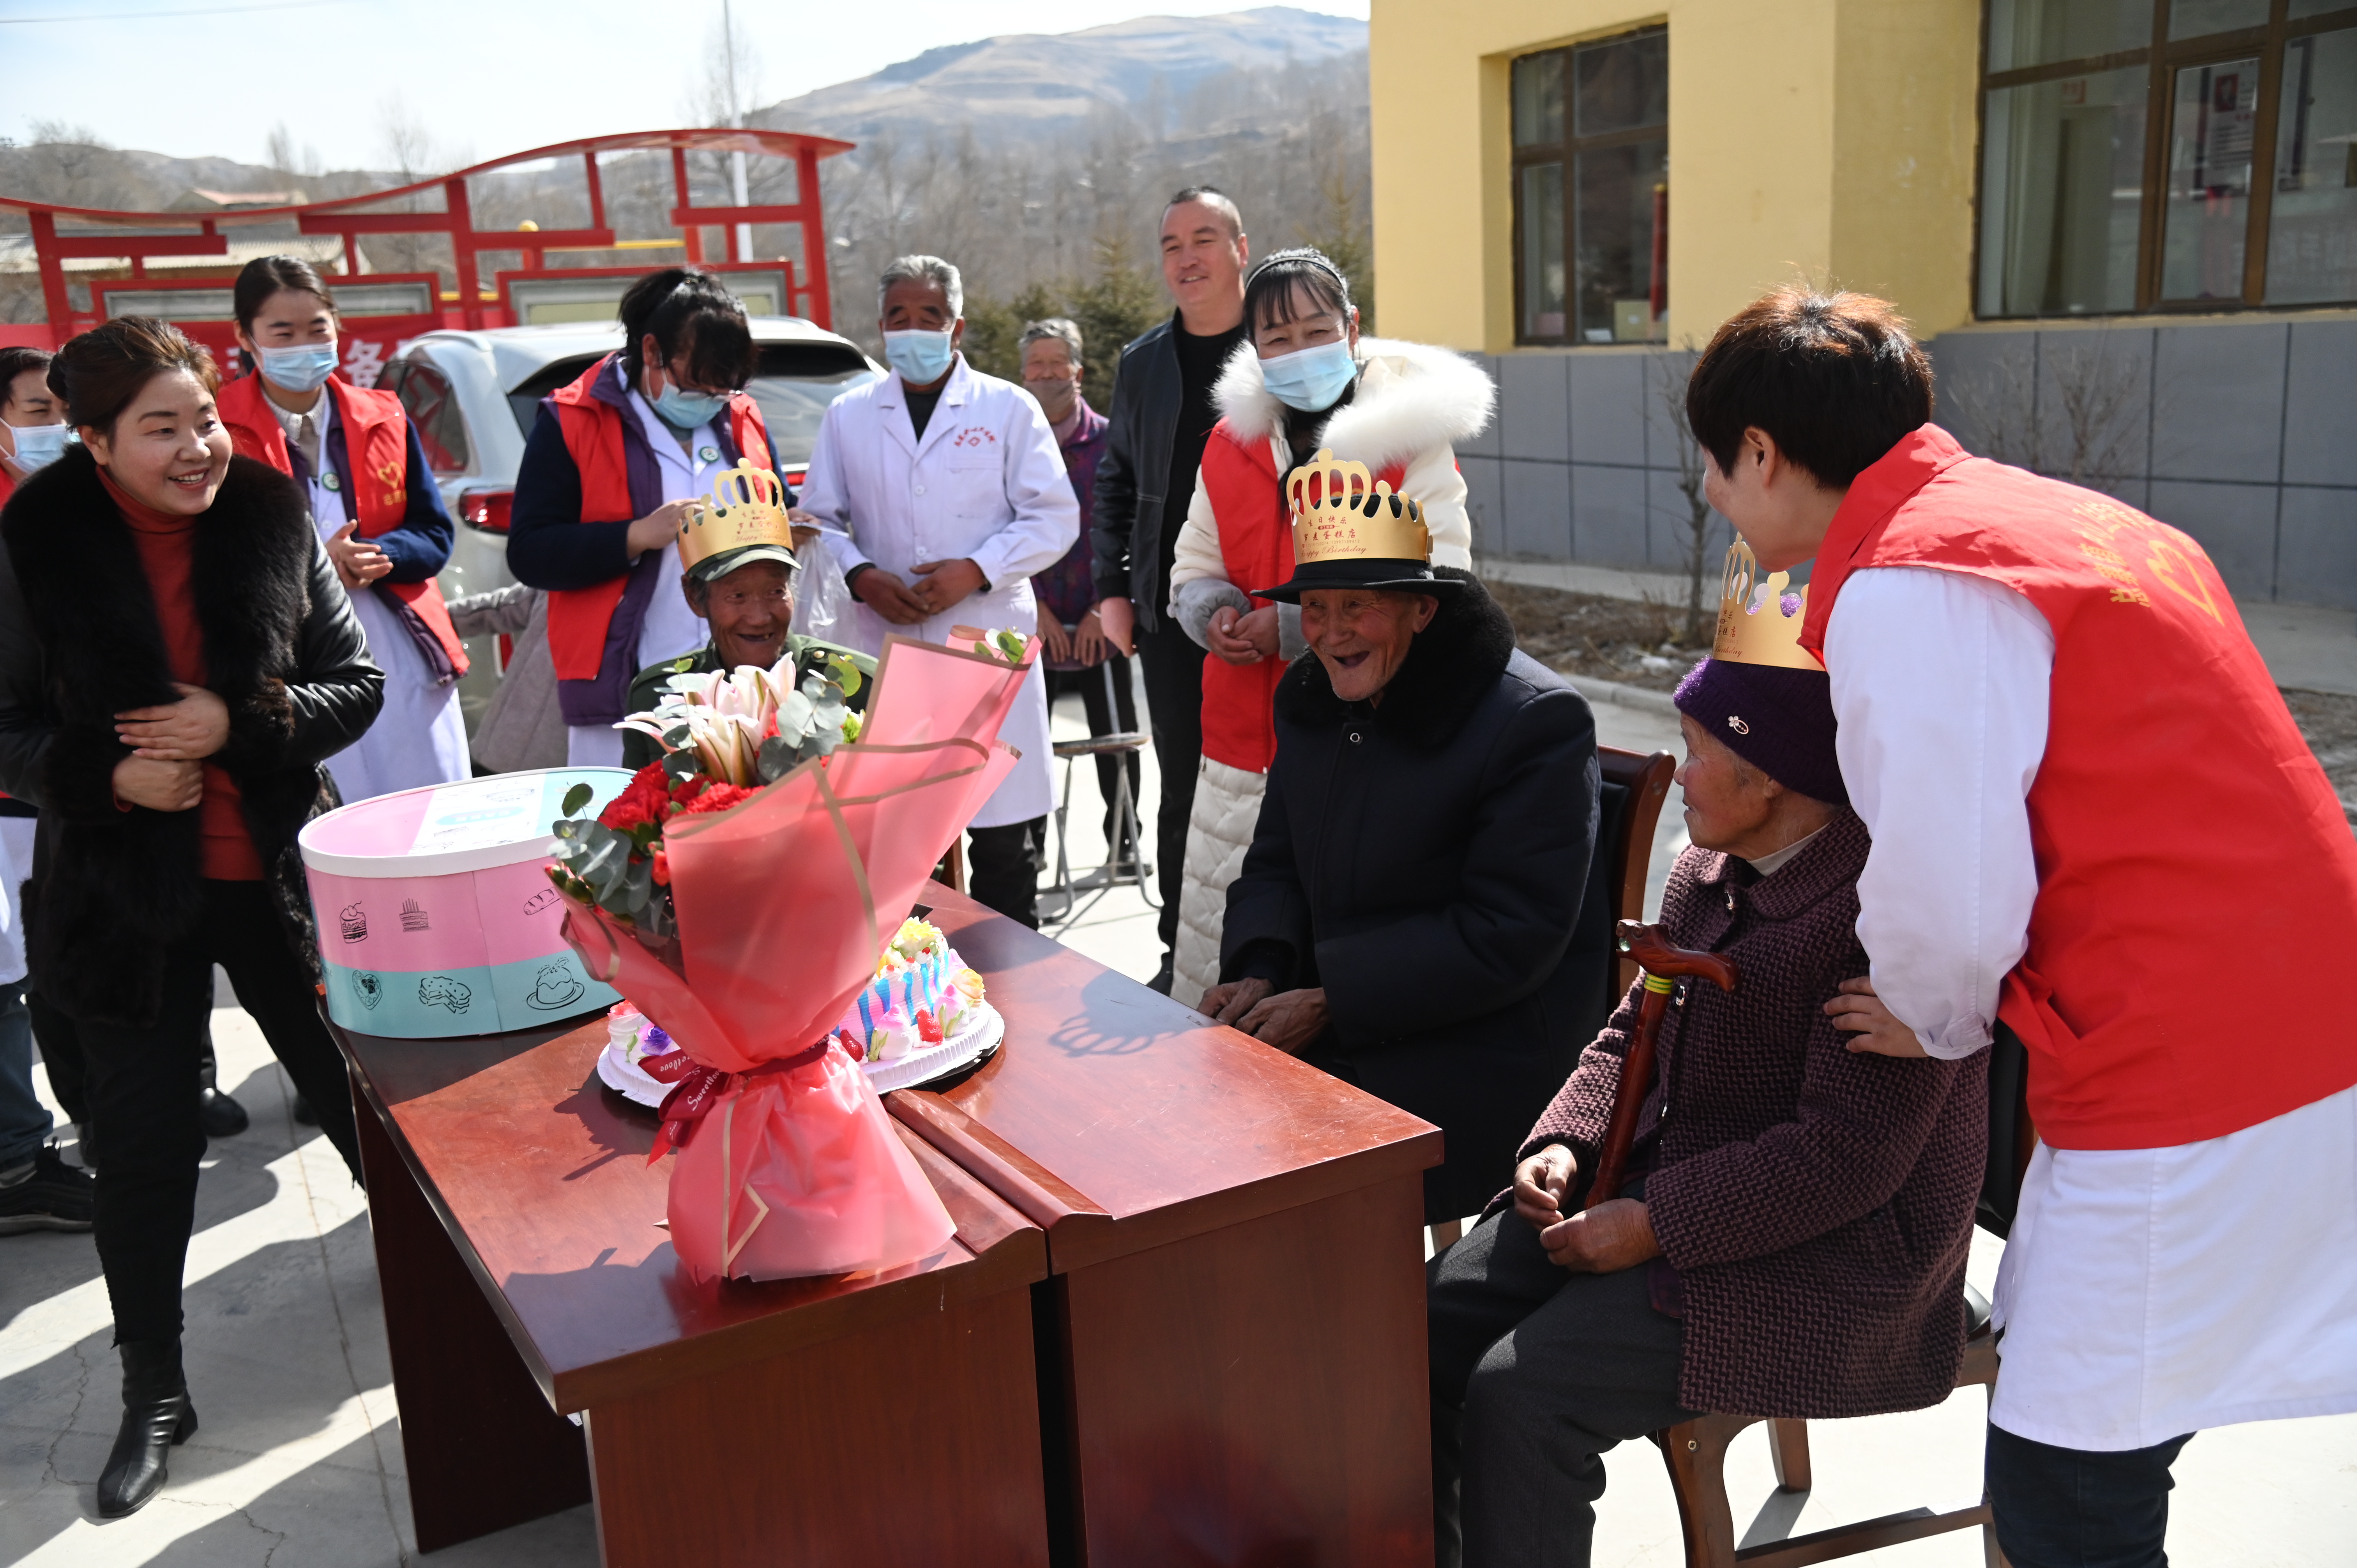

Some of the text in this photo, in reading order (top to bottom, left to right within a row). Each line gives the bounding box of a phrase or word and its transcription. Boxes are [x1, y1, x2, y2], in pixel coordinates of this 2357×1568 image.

[1308, 515, 1346, 527] 生日快乐
[1322, 545, 1367, 554] Birthday
